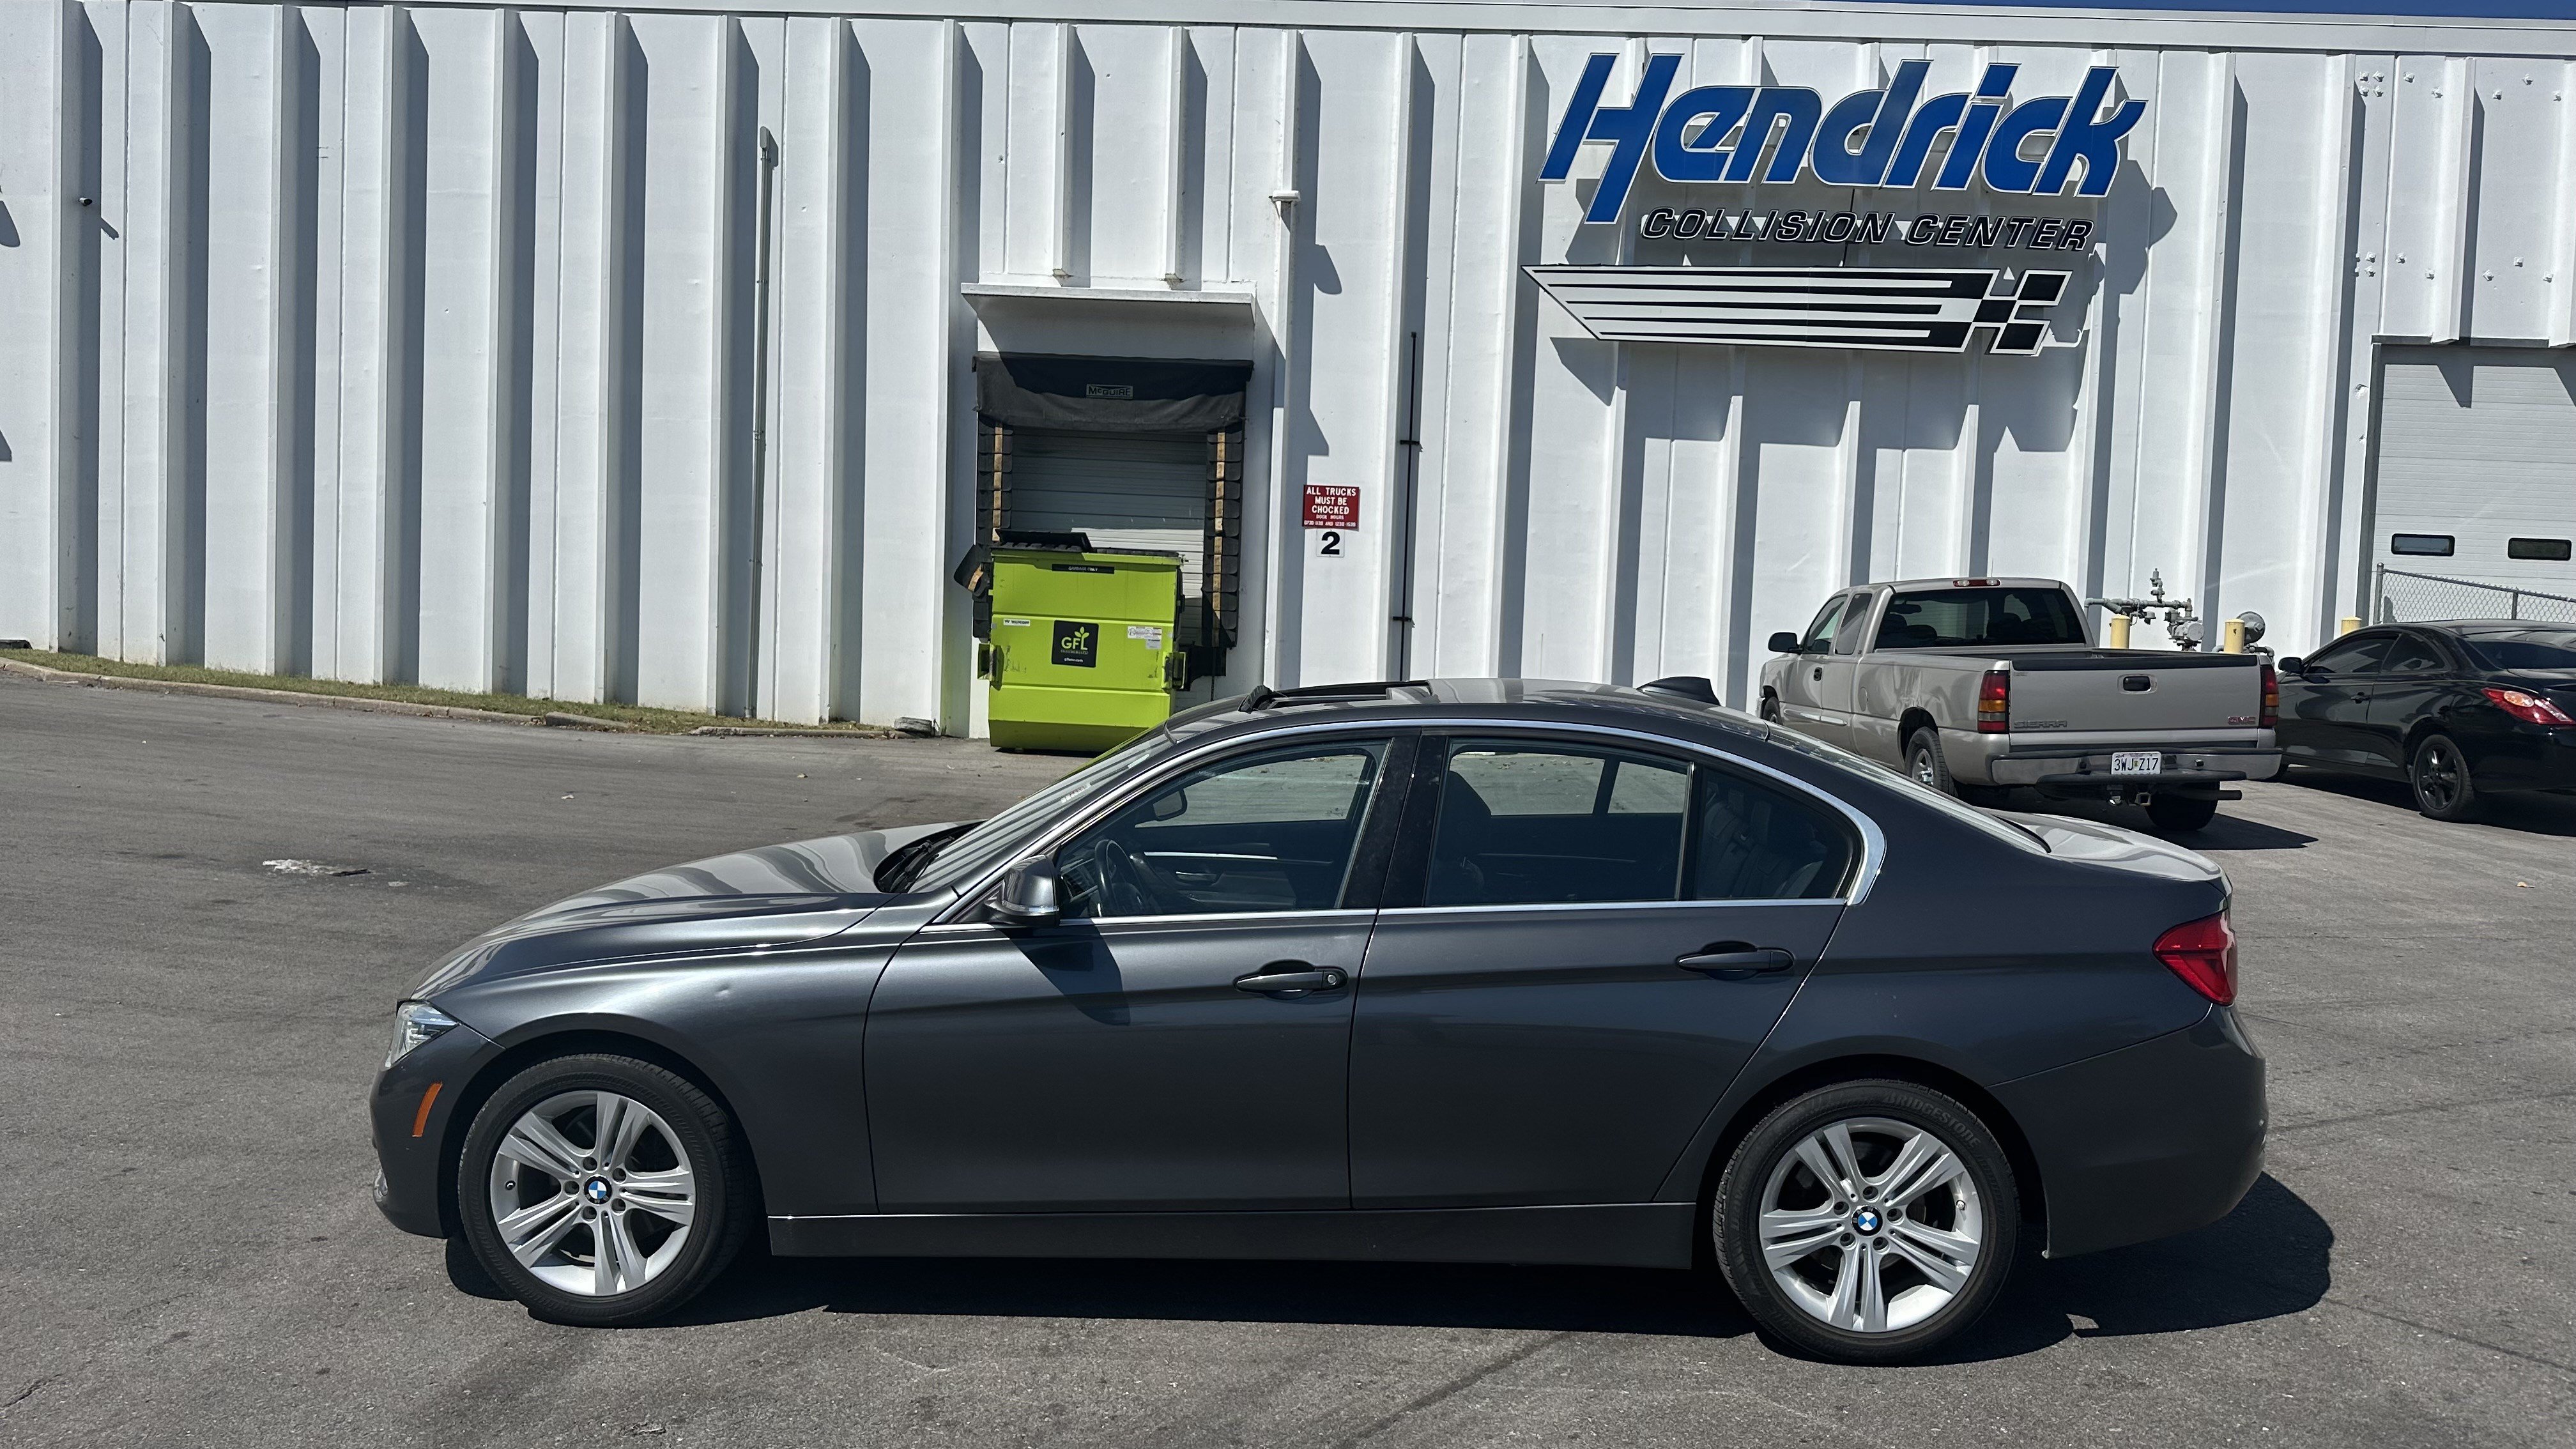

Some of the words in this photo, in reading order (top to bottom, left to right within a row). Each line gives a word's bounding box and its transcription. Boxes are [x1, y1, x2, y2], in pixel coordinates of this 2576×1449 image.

[1535, 52, 2147, 224] Hendrick
[1641, 208, 1896, 244] COLLISION
[1905, 214, 2095, 252] CENTER
[1307, 487, 1321, 495] ALL
[1326, 487, 1356, 496] TRUCKS
[1315, 496, 1335, 505] MUST
[1337, 497, 1347, 505] BE
[1311, 505, 1349, 515] CHOCKED
[1321, 531, 1340, 555] 2
[1061, 634, 1089, 650] GFL
[2014, 720, 2067, 729] SIERRA
[2114, 758, 2134, 771] 3WJ
[2138, 757, 2159, 770] Z17
[1883, 1090, 1981, 1147] BRIDGESTONE
